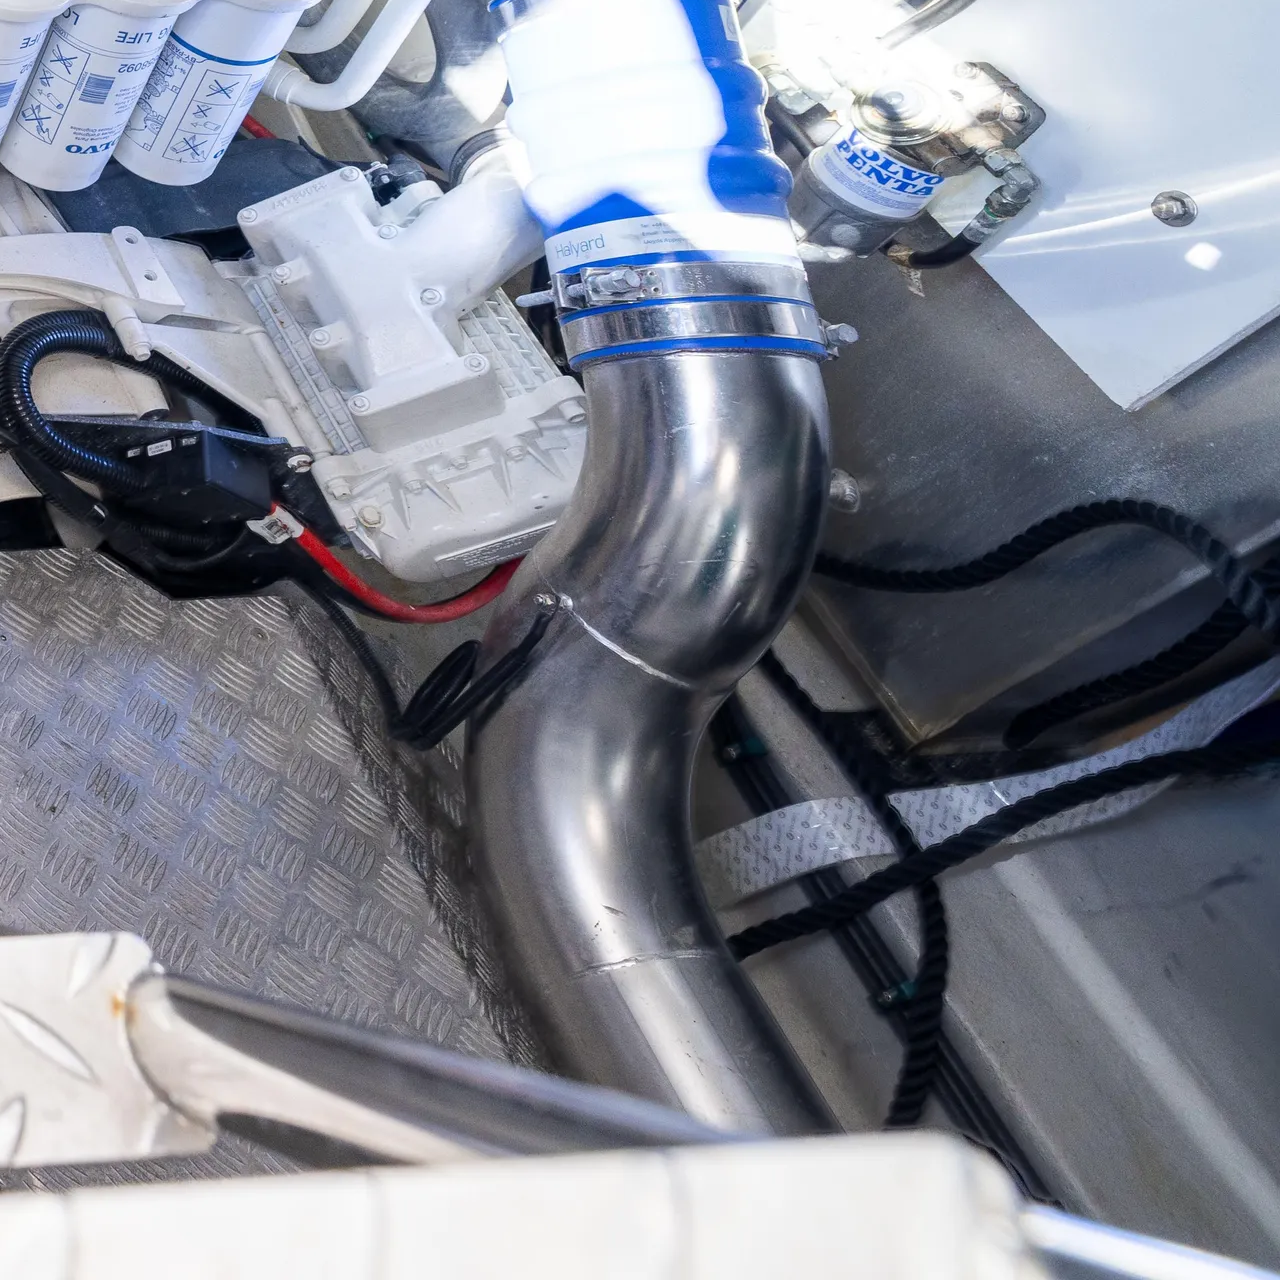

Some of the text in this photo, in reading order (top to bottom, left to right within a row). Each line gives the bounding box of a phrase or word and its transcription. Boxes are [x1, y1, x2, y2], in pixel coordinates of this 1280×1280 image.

[114, 31, 153, 44] LIFE
[836, 139, 934, 197] PENTA
[848, 128, 945, 186] VOLVO
[555, 233, 605, 259] Halyard
